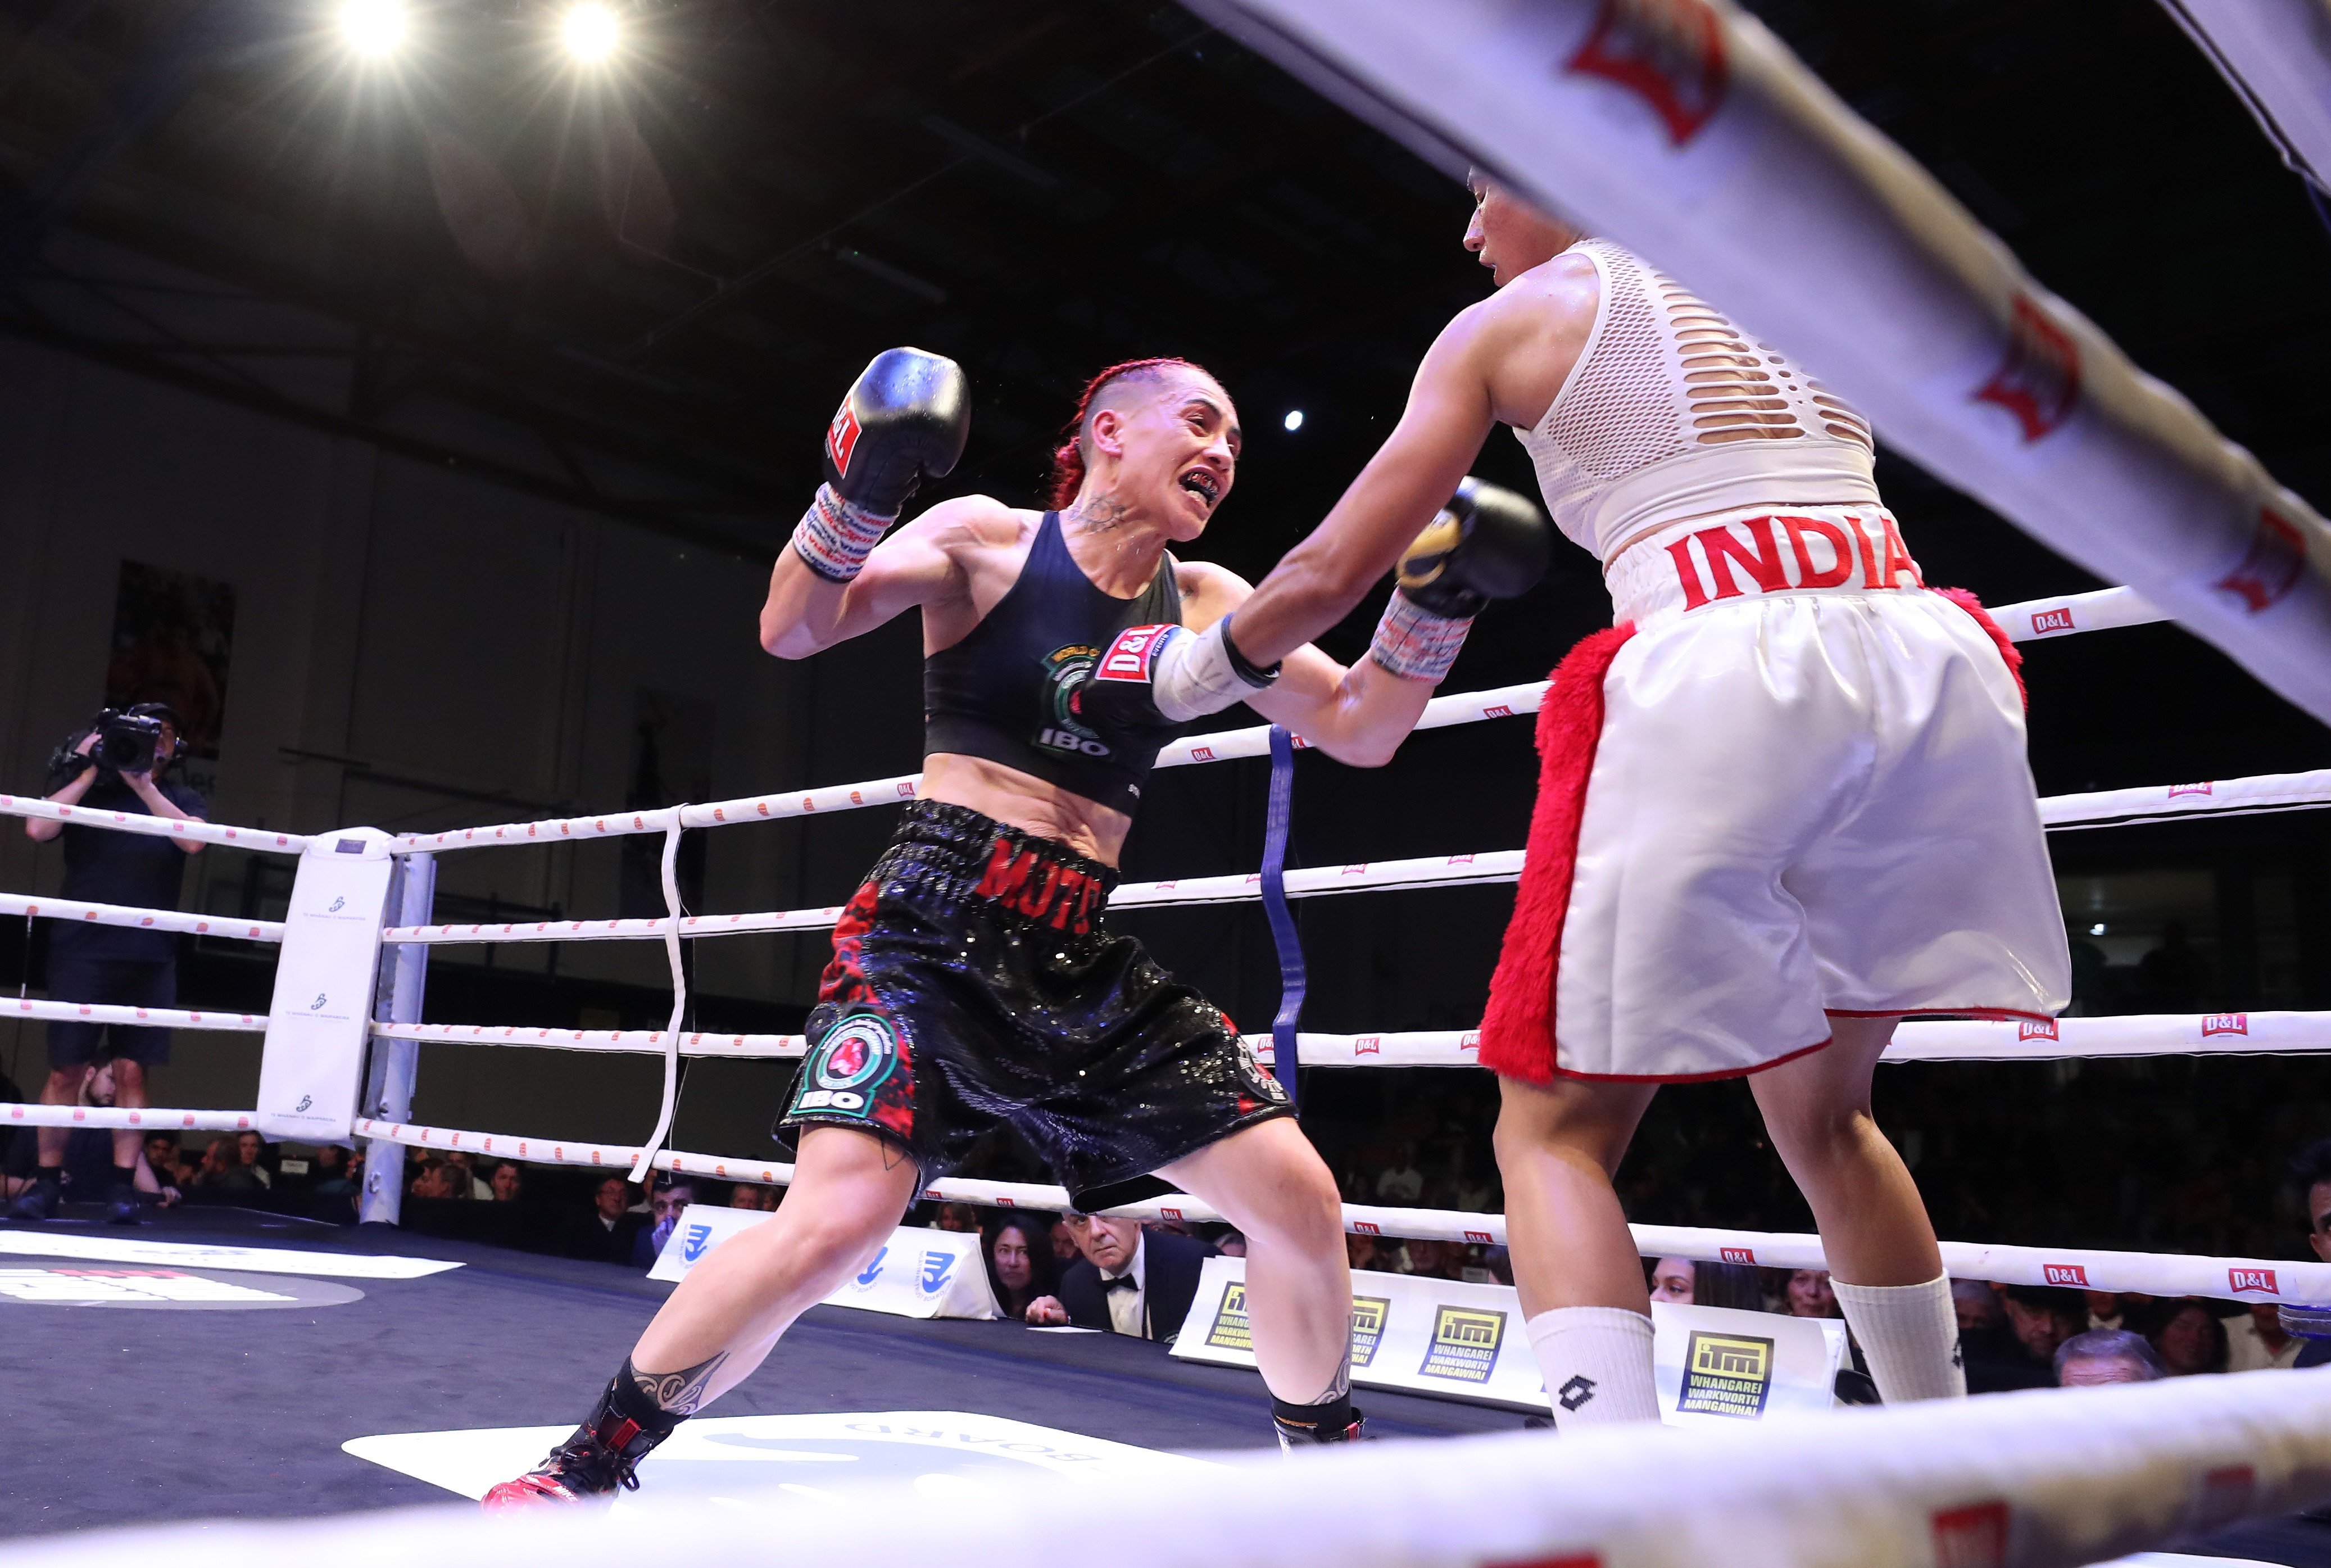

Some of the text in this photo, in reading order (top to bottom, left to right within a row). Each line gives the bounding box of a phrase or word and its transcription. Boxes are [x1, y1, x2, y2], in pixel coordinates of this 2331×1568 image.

[1665, 515, 1924, 611] INDIA
[2036, 613, 2070, 631] D&L
[1106, 624, 1164, 672] D&L
[1040, 728, 1111, 756] IBO
[2206, 1016, 2243, 1031] D&L
[1358, 1039, 1377, 1052] D&L
[799, 1090, 864, 1109] IBO
[2048, 1267, 2083, 1284] D&L
[2233, 1271, 2273, 1290] D&L
[1433, 1344, 1494, 1361] WHANGAREI
[1429, 1354, 1490, 1371] WARKWORTH
[1424, 1364, 1487, 1380] MANGAWHAI
[1690, 1374, 1763, 1394] WHANGAREI
[1688, 1387, 1761, 1406] WARKWORTH
[1684, 1399, 1758, 1416] MANGAWHAI
